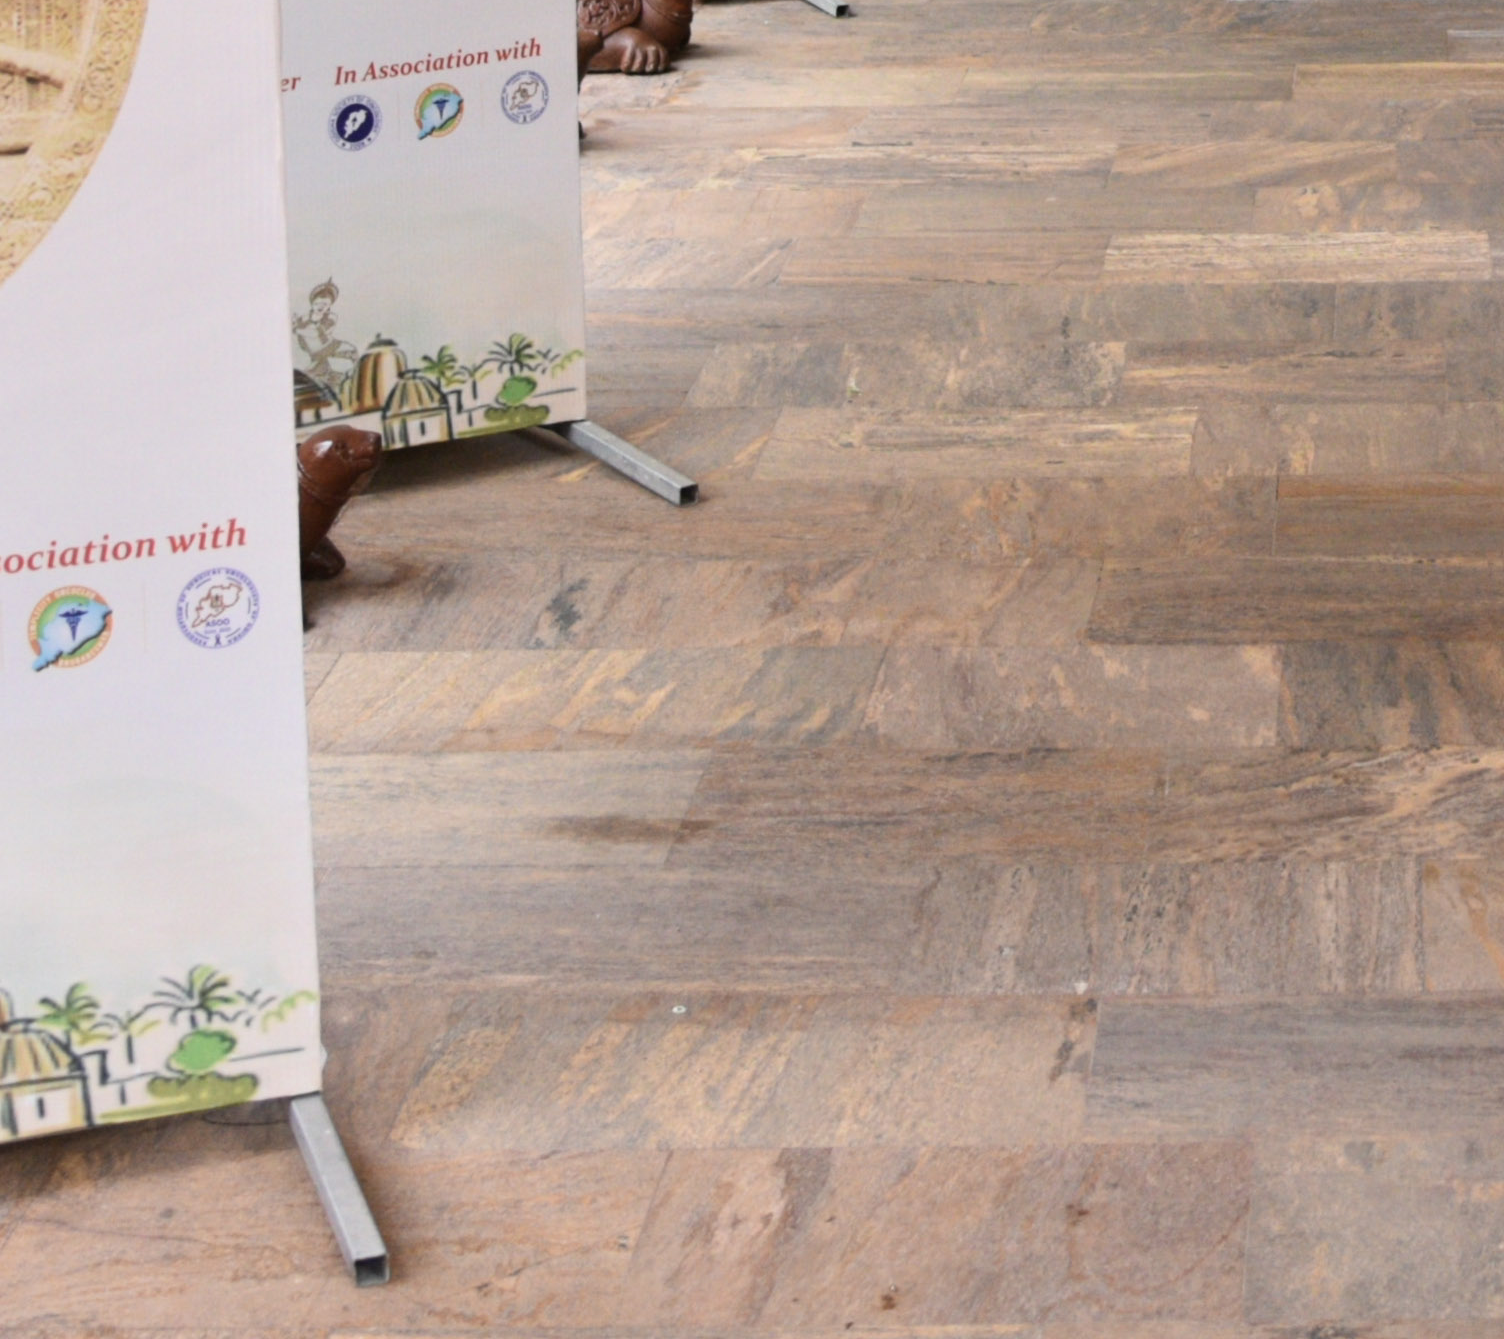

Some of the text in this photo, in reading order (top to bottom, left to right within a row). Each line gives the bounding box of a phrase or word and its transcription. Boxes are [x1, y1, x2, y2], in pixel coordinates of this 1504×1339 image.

[335, 38, 540, 85] In Association with
[168, 518, 245, 553] with
